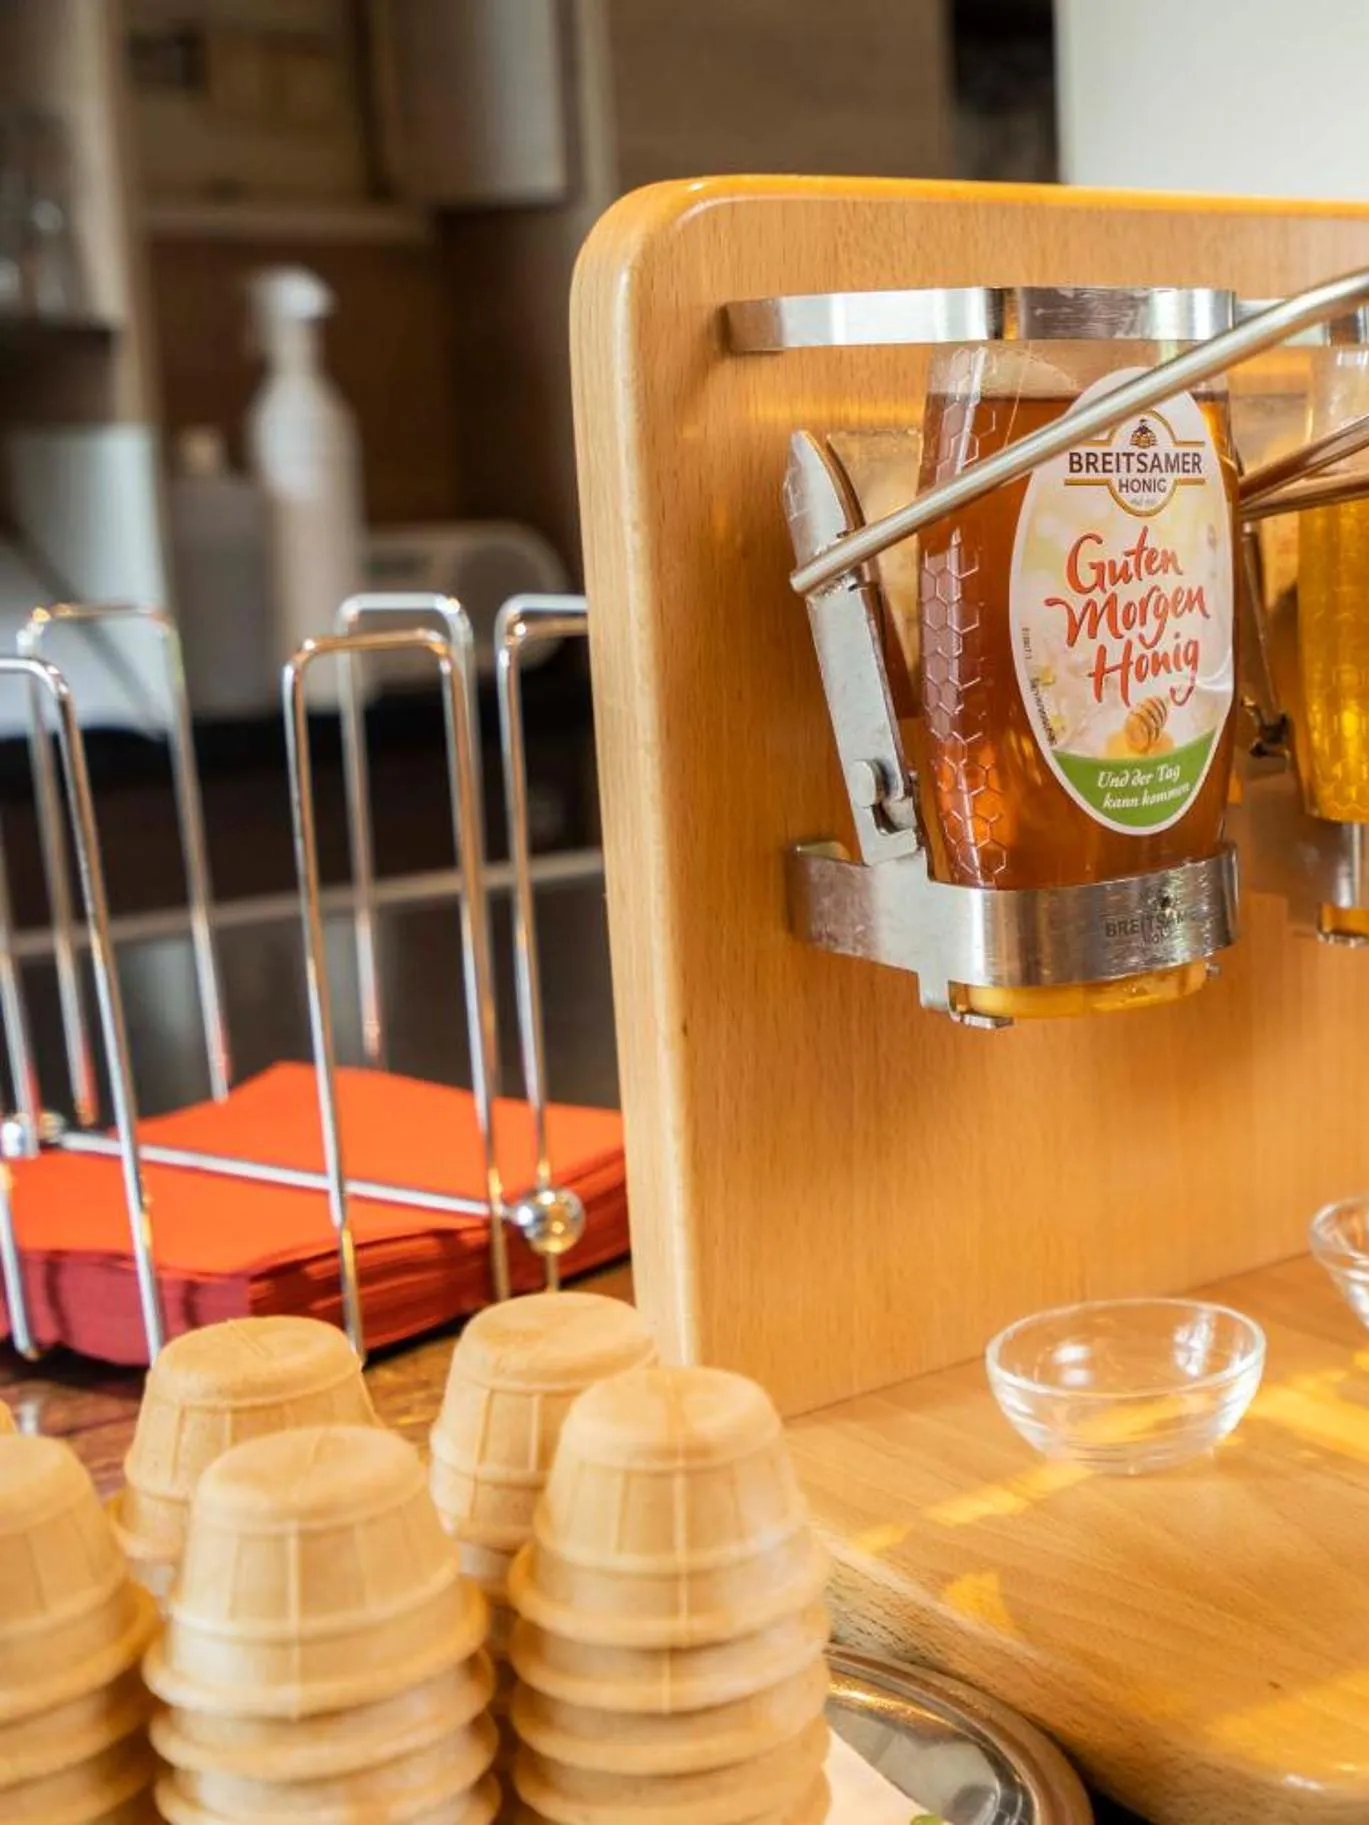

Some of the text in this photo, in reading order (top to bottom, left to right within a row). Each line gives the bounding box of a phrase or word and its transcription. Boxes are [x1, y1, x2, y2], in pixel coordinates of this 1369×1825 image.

[1068, 451, 1202, 474] BREITSAMER
[1118, 478, 1167, 494] HONIG
[1066, 525, 1183, 595] Guten
[1044, 584, 1211, 649] Morgen
[1088, 632, 1199, 707] Honig
[1098, 763, 1181, 789] Und der Tag
[1103, 791, 1139, 810] kann
